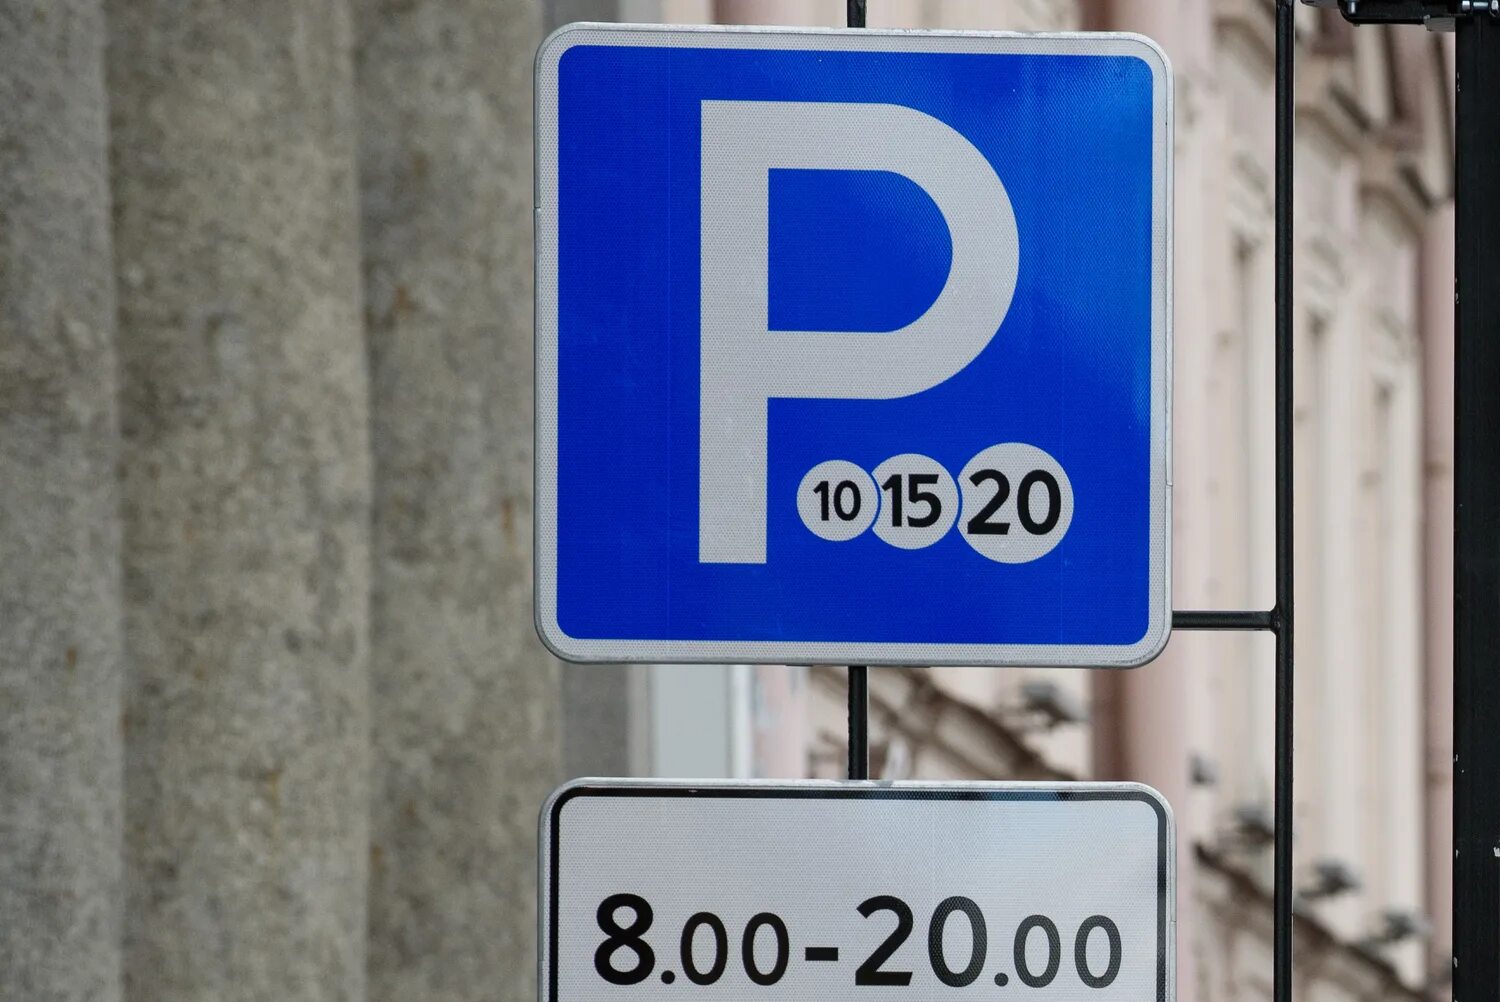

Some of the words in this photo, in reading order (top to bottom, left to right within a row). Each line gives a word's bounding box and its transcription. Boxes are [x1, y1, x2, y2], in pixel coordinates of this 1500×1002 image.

[699, 99, 1020, 564] P
[812, 480, 861, 522] 10
[880, 473, 942, 528] 15
[966, 469, 1061, 535] 20
[594, 893, 1122, 989] 8.00-20.00
